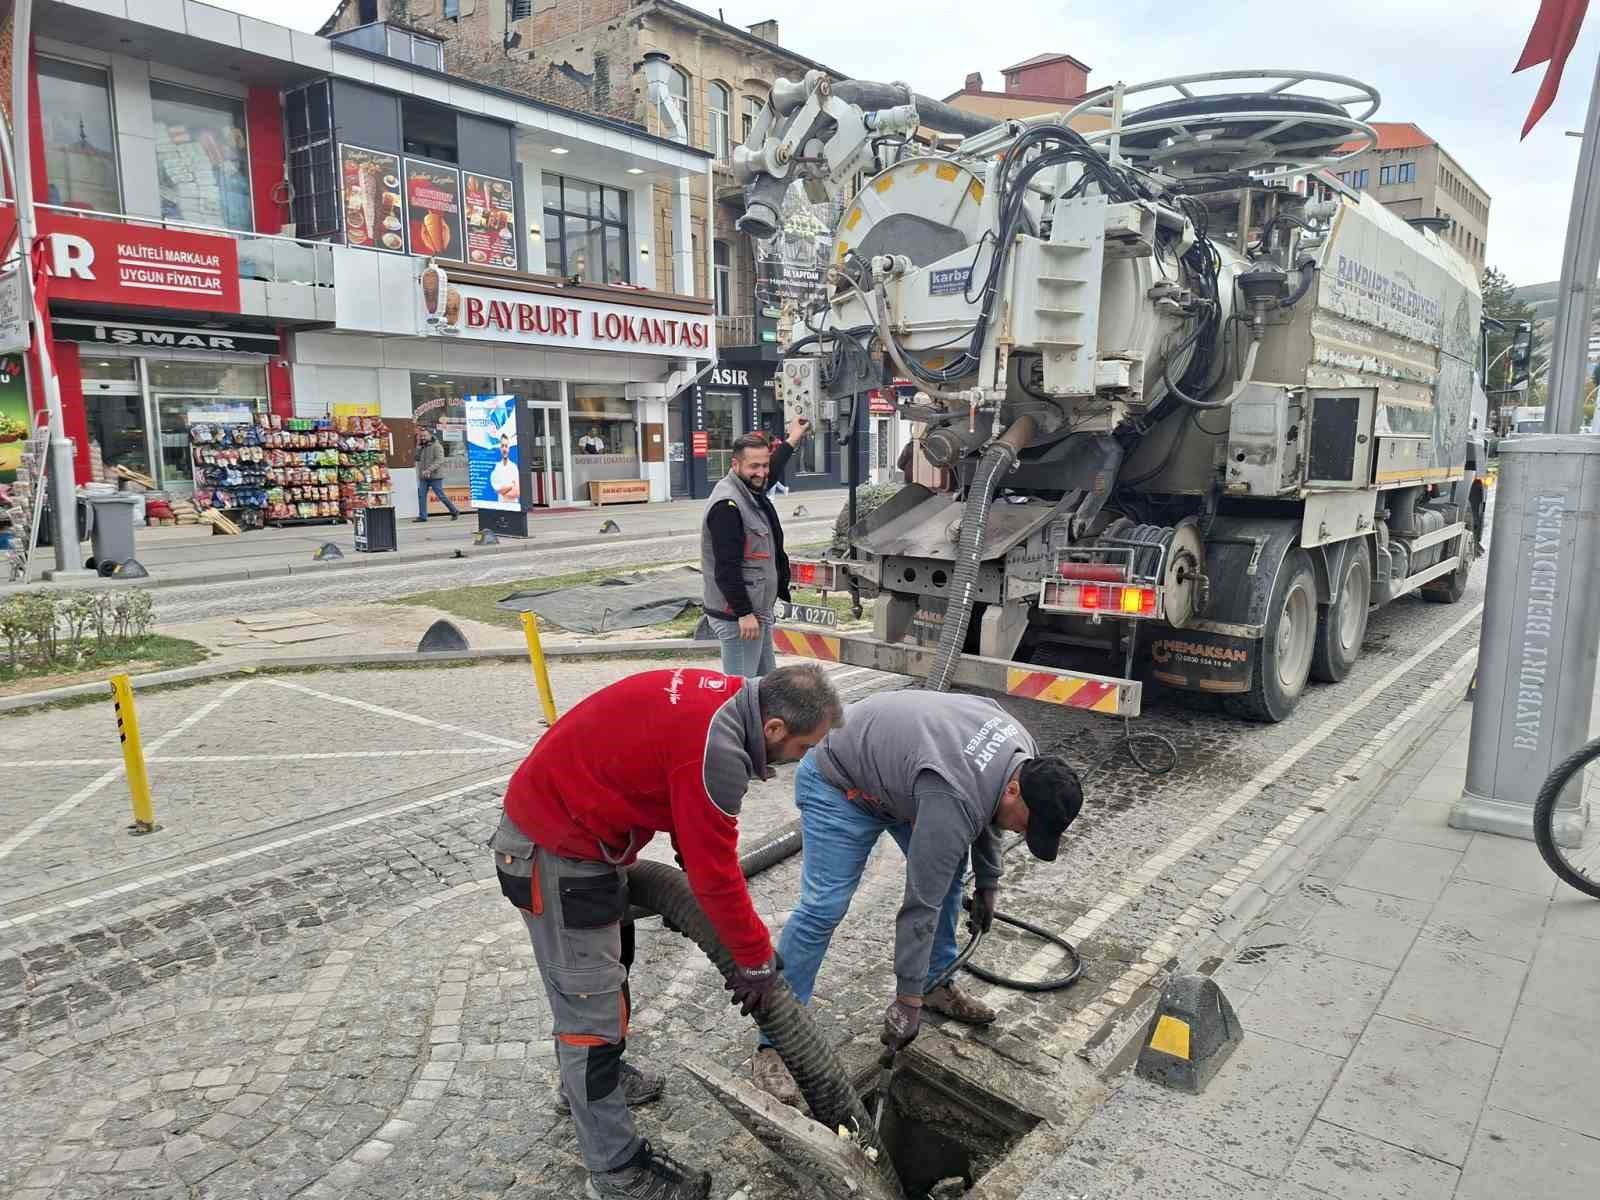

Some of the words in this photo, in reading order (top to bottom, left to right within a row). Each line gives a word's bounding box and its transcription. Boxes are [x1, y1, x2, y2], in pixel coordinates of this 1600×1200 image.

[118, 243, 163, 261] KALİTELİ
[165, 248, 220, 267] MARKALAR
[120, 268, 165, 284] UYGUN
[166, 270, 221, 289] FİYATLAR
[464, 297, 582, 337] BAYBURT
[591, 311, 709, 348] LOKANTASI
[710, 368, 749, 386] ASIR
[791, 606, 799, 619] K
[806, 608, 835, 625] 0270
[1513, 642, 1548, 750] BAYBURT
